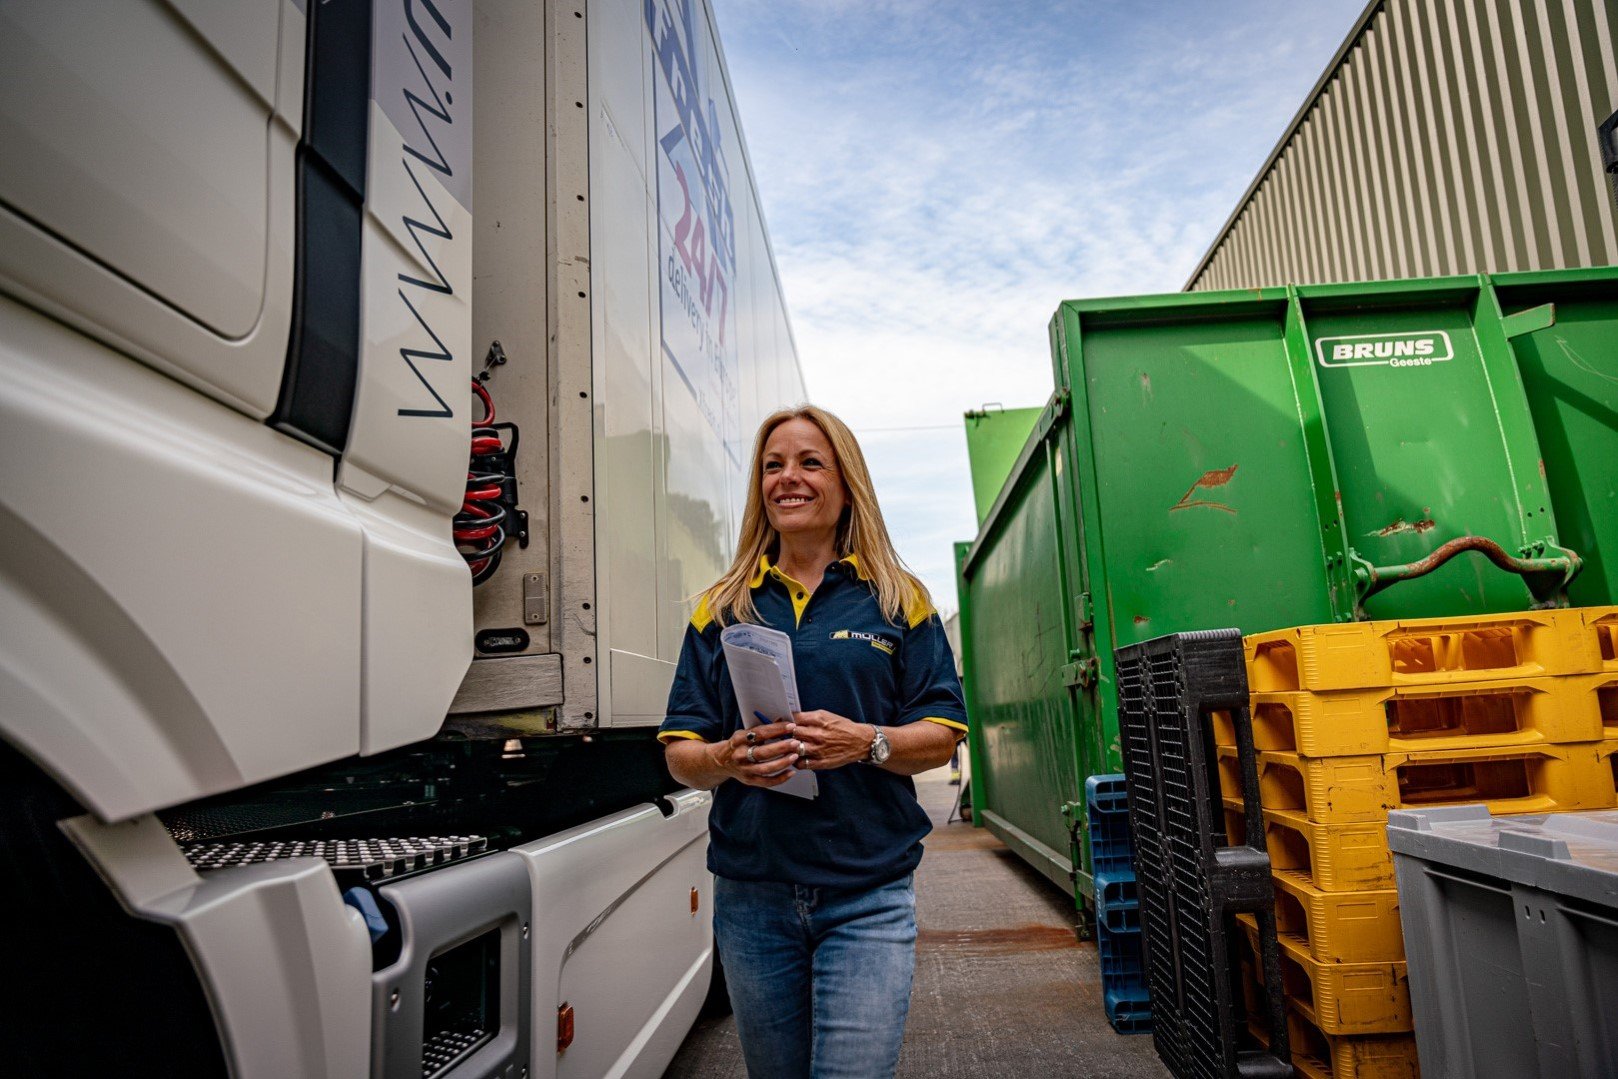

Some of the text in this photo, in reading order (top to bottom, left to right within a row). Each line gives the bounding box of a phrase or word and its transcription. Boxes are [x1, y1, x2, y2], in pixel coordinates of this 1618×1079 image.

[674, 159, 728, 348] 24/7
[668, 244, 704, 352] delivery
[1332, 338, 1434, 360] BRUNS
[1389, 356, 1432, 368] Geeste
